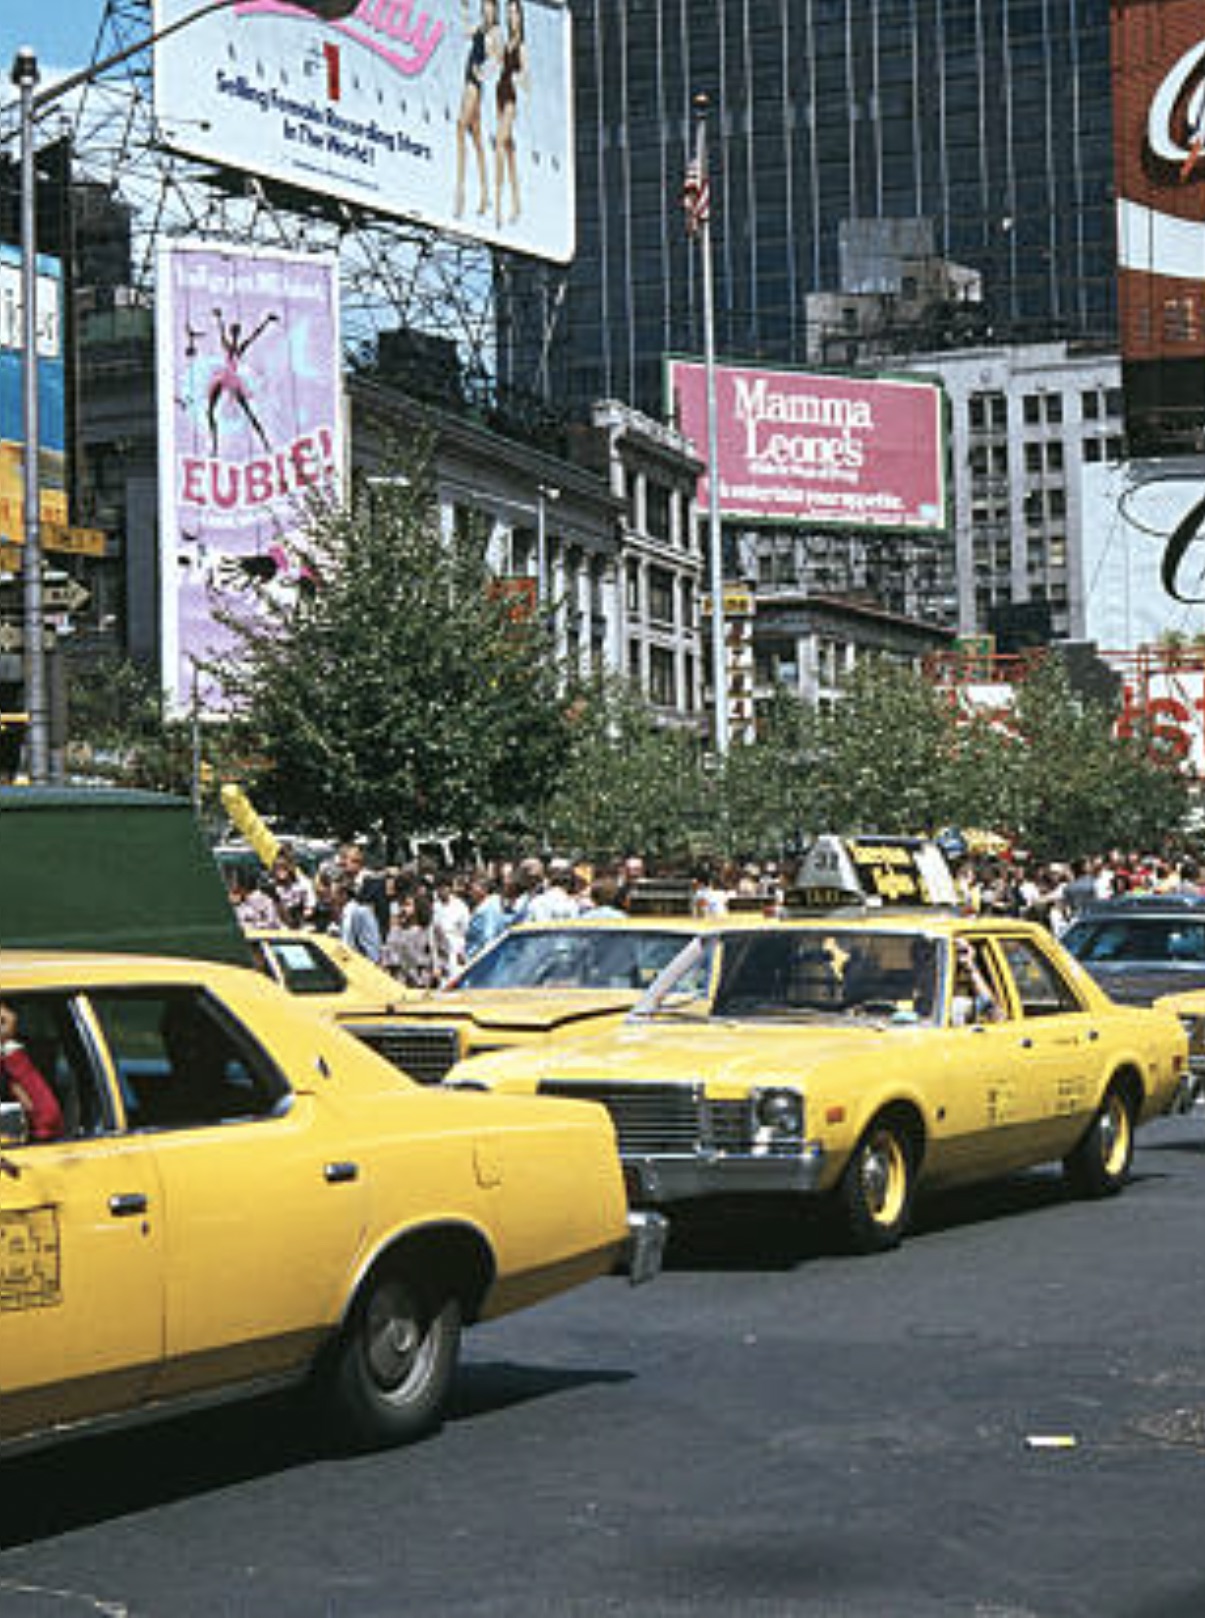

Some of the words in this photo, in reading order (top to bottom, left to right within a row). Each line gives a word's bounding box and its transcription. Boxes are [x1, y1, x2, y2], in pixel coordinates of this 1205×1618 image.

[323, 41, 340, 101] 1
[217, 69, 269, 112] Selling
[270, 88, 324, 123] Female
[325, 107, 395, 152] Recording
[397, 131, 431, 160] Stars
[283, 118, 297, 140] In
[298, 122, 324, 149] The
[325, 134, 376, 168] World!
[733, 377, 874, 428] Mamma
[182, 429, 334, 509] EUBIE!
[743, 419, 864, 467] Leone's
